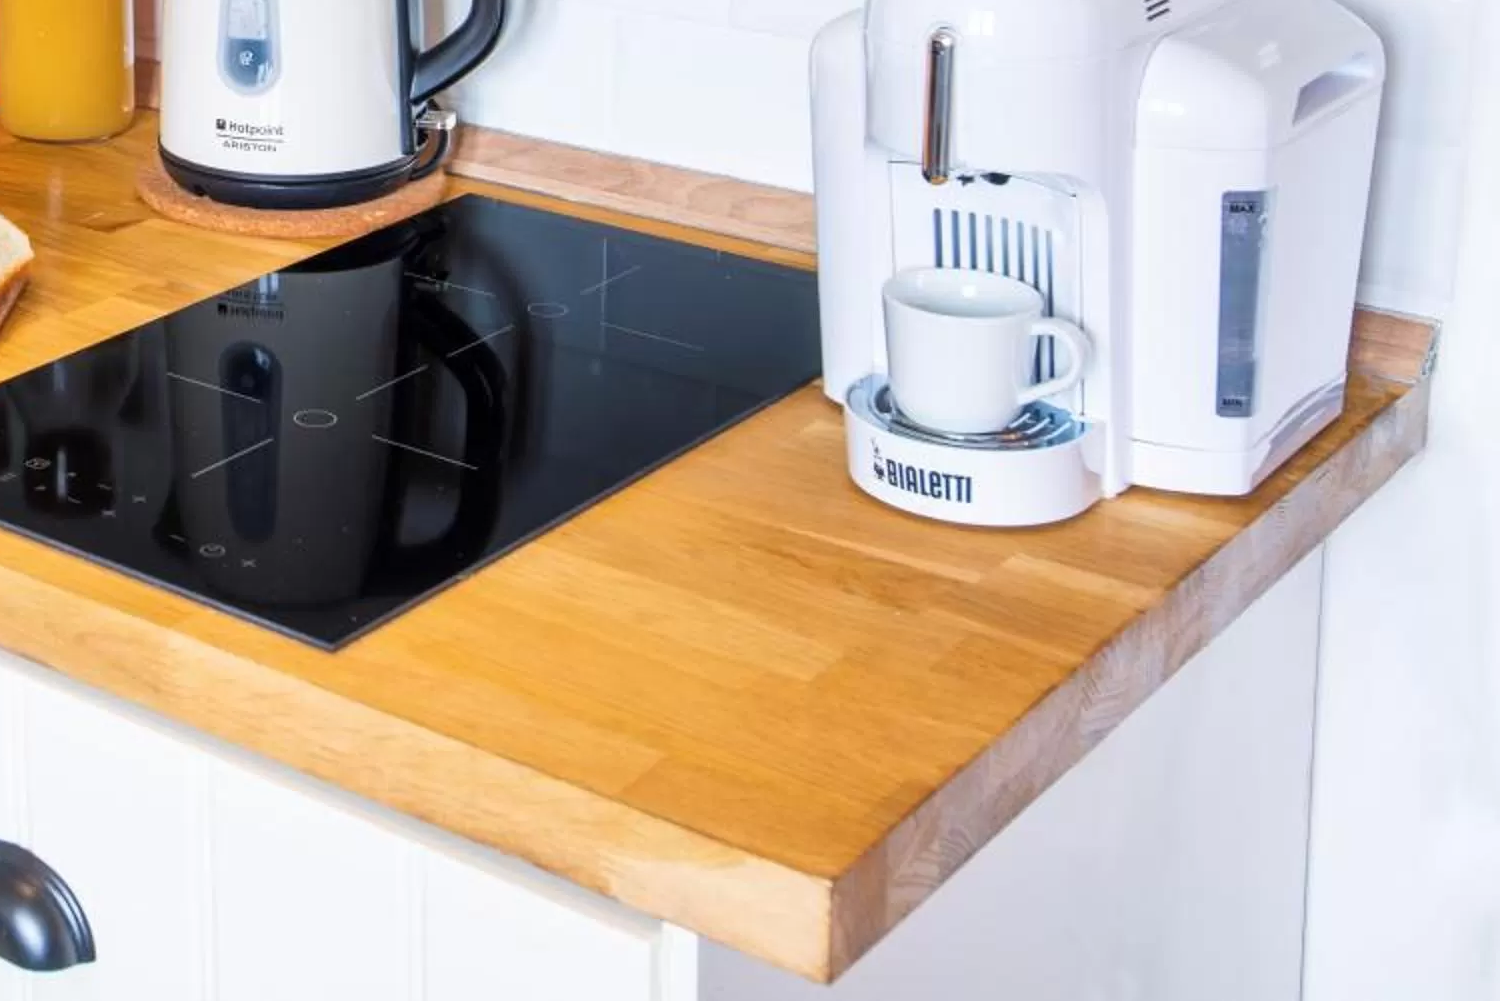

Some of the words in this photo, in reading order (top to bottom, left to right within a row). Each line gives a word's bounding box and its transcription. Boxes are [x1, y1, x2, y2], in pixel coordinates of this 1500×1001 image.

[229, 120, 285, 136] Hotpoint
[222, 140, 277, 152] ARISTON
[1228, 203, 1255, 213] MAX
